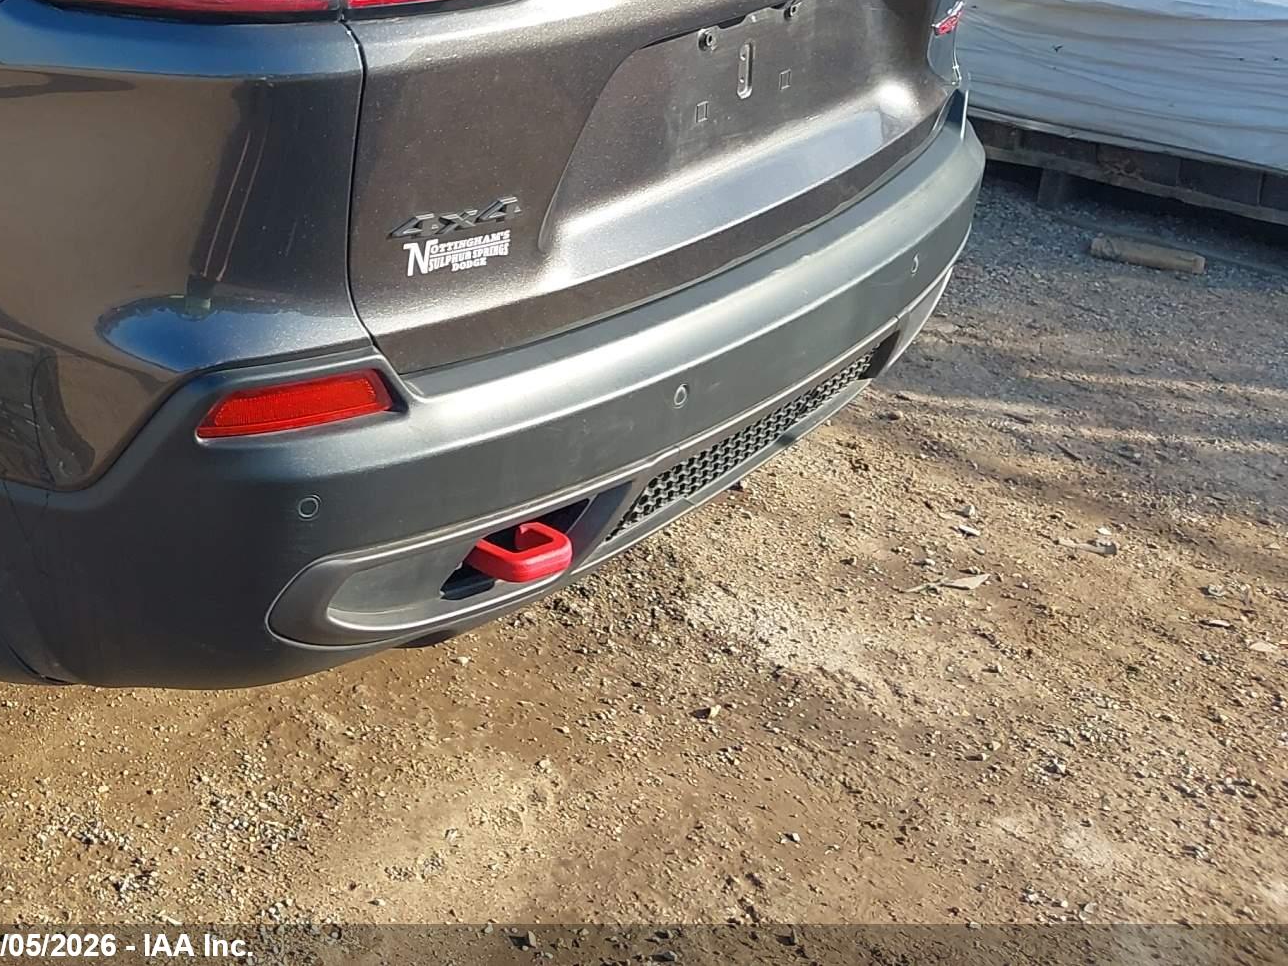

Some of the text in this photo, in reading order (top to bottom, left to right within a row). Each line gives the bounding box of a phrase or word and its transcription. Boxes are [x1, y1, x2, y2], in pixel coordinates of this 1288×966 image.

[429, 242, 509, 272] SULPHUR SPRINGS
[451, 257, 487, 272] DODGE
